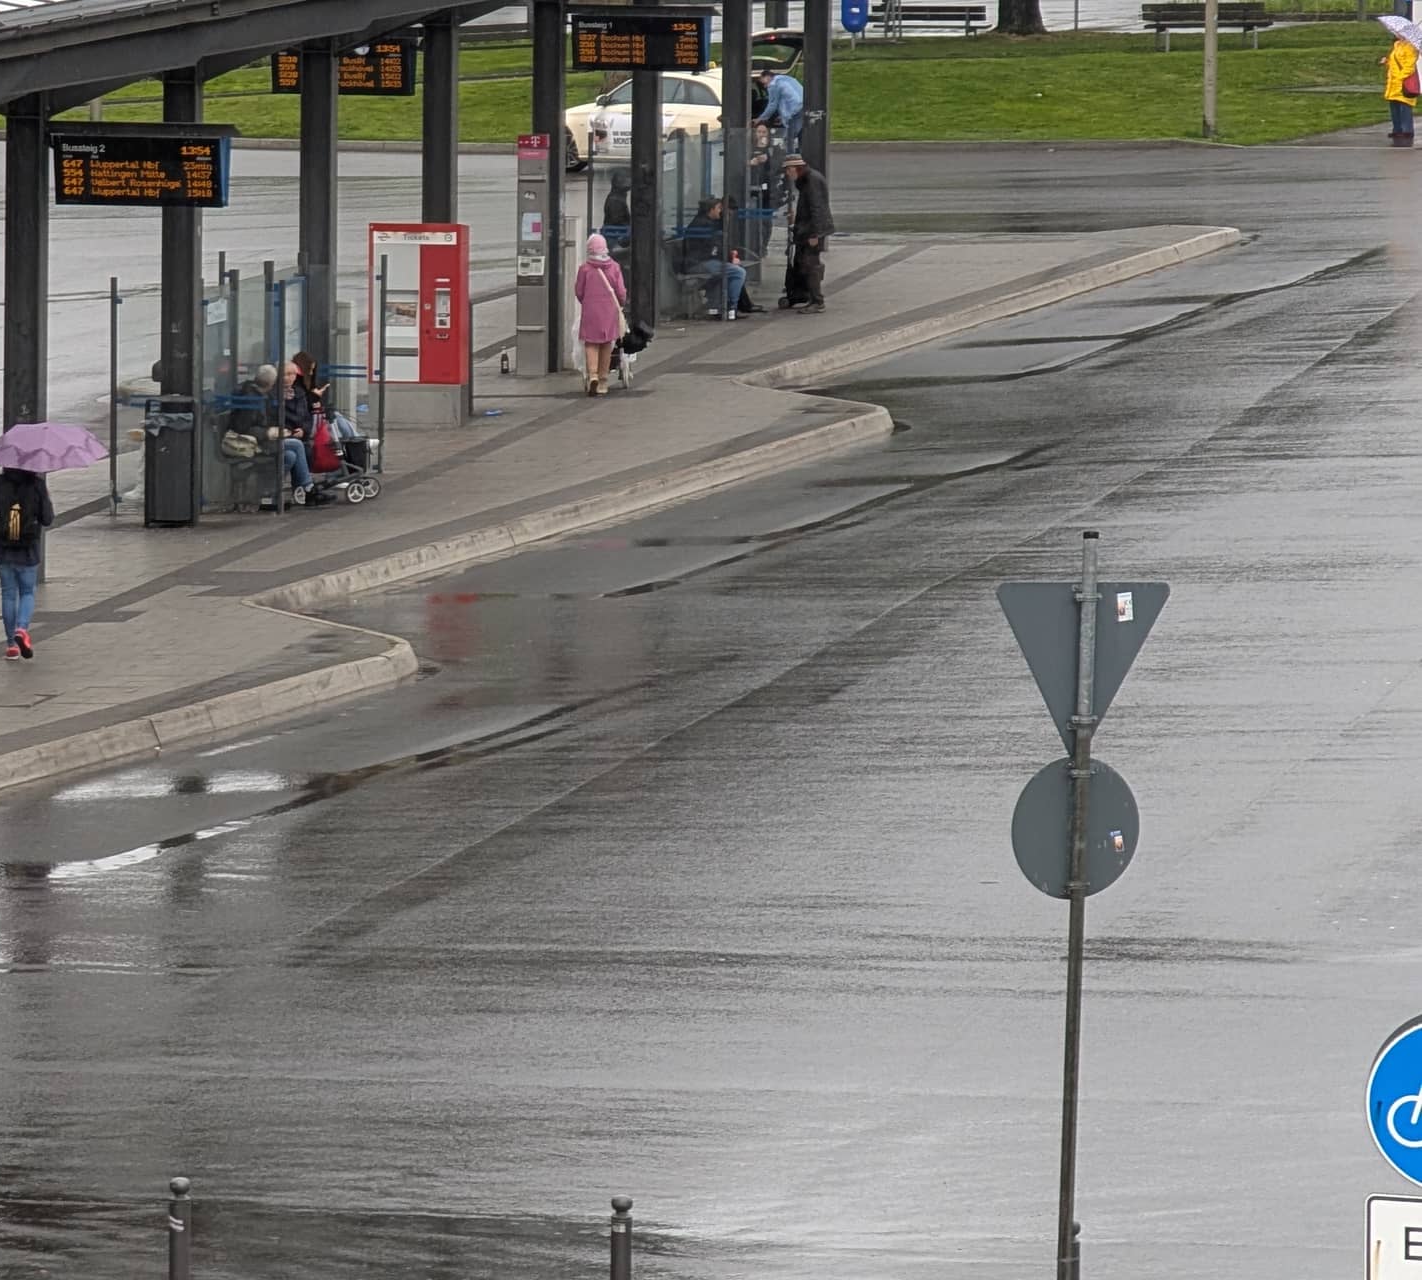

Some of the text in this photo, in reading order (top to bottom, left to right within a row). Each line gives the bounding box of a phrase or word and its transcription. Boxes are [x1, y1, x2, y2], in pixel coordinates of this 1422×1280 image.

[62, 144, 106, 154] Bussteig 2
[180, 146, 210, 155] 13:54
[62, 159, 83, 168] 647
[63, 177, 84, 186] 647
[64, 186, 84, 195] 647
